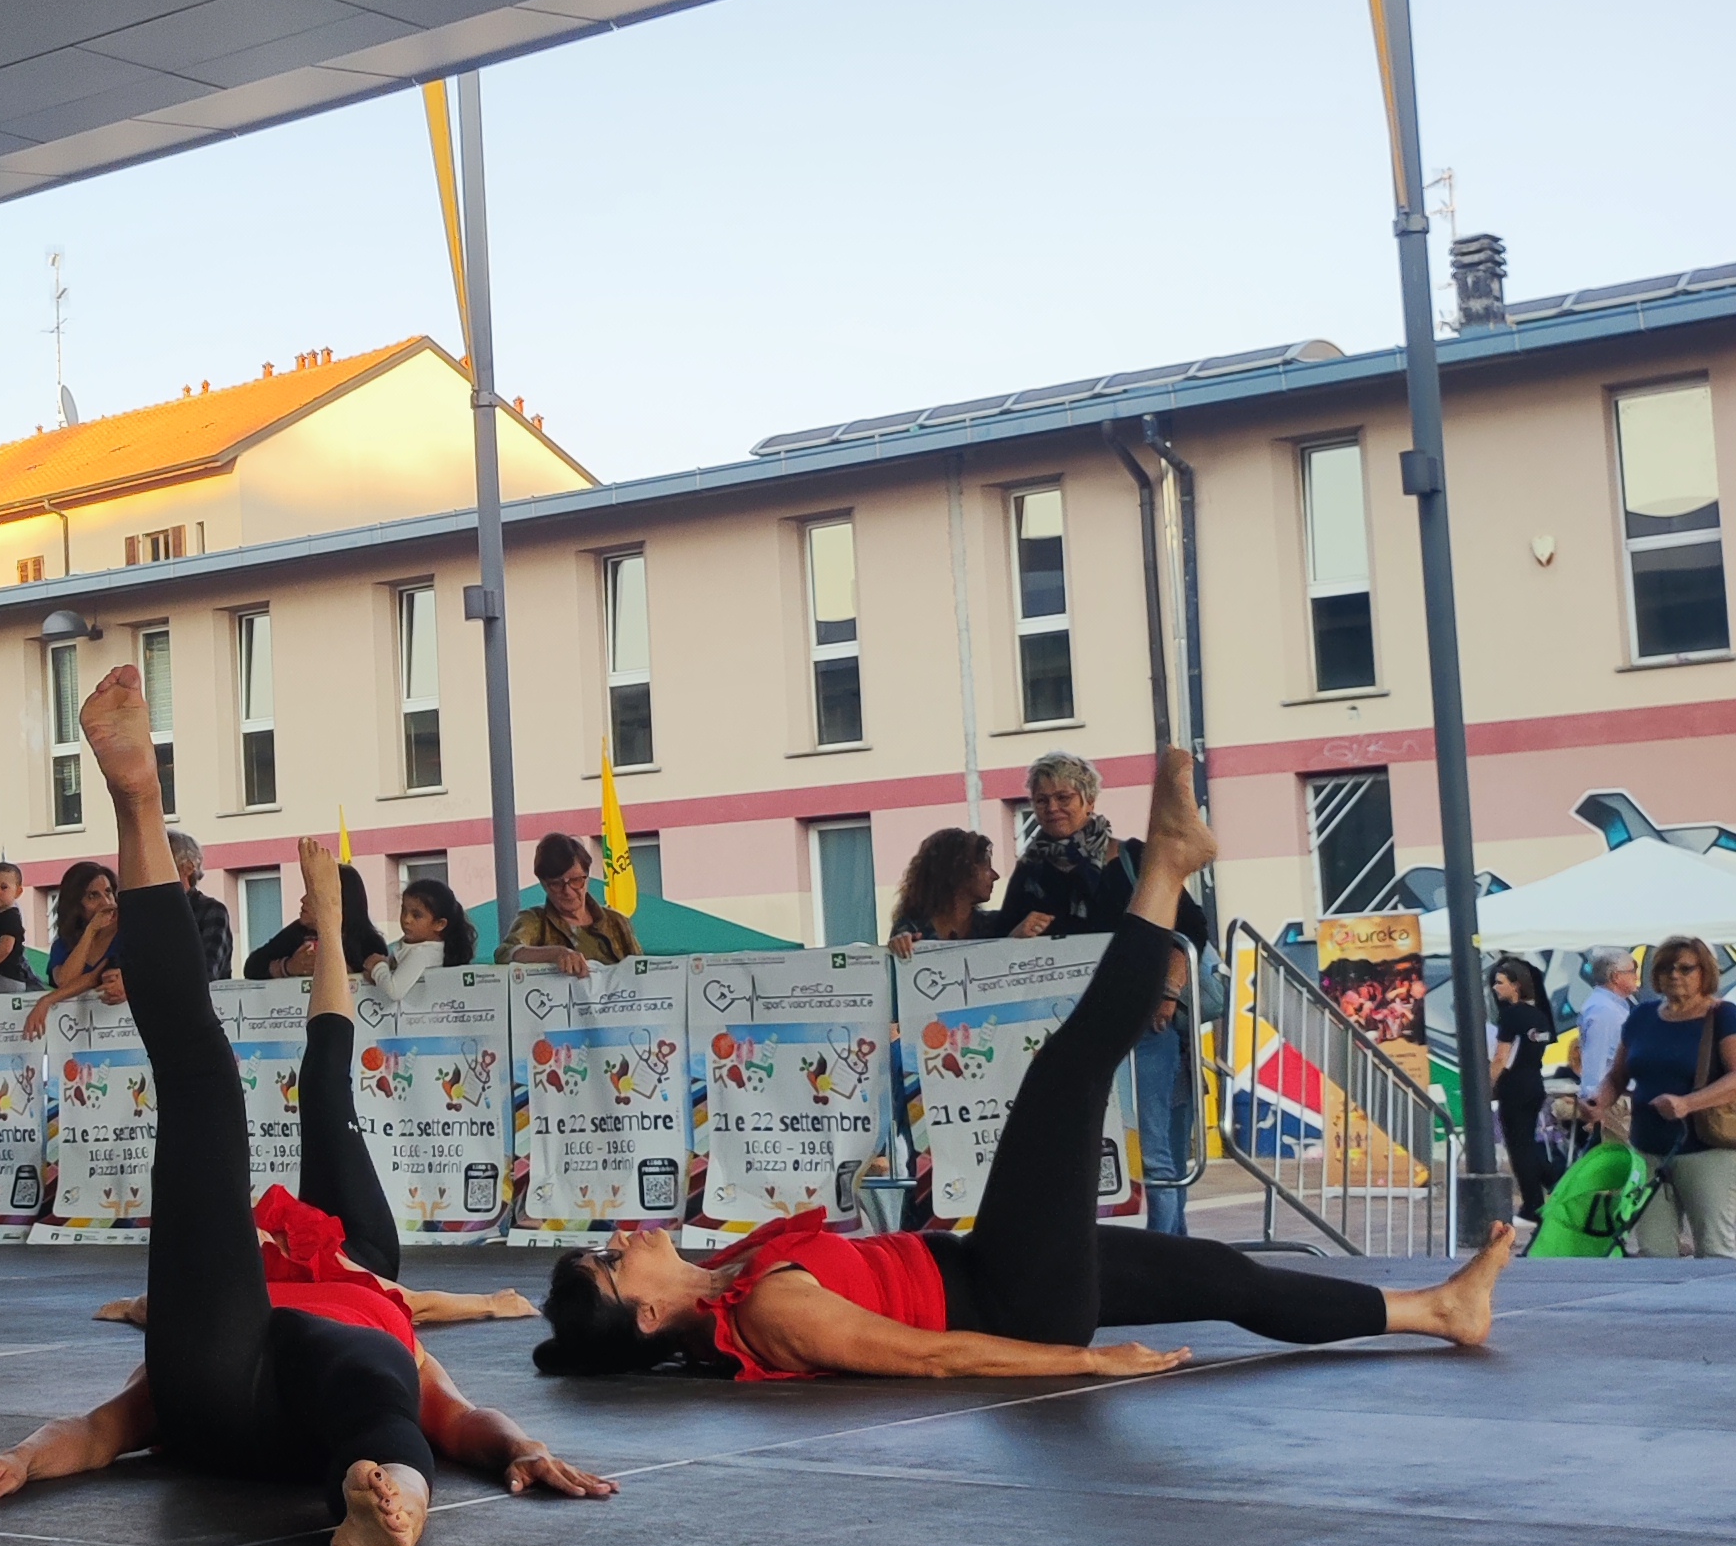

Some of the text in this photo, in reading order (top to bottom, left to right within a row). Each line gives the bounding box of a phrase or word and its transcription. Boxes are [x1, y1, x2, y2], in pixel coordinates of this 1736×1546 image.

[534, 1111, 673, 1135] 21 e 22 settembre
[713, 1112, 871, 1132] 21 e 22 settembre
[929, 1099, 1000, 1126] 21 e 22
[63, 1123, 157, 1143] 21 e 22 settemb
[358, 1116, 495, 1137] 21 e 22 settembre
